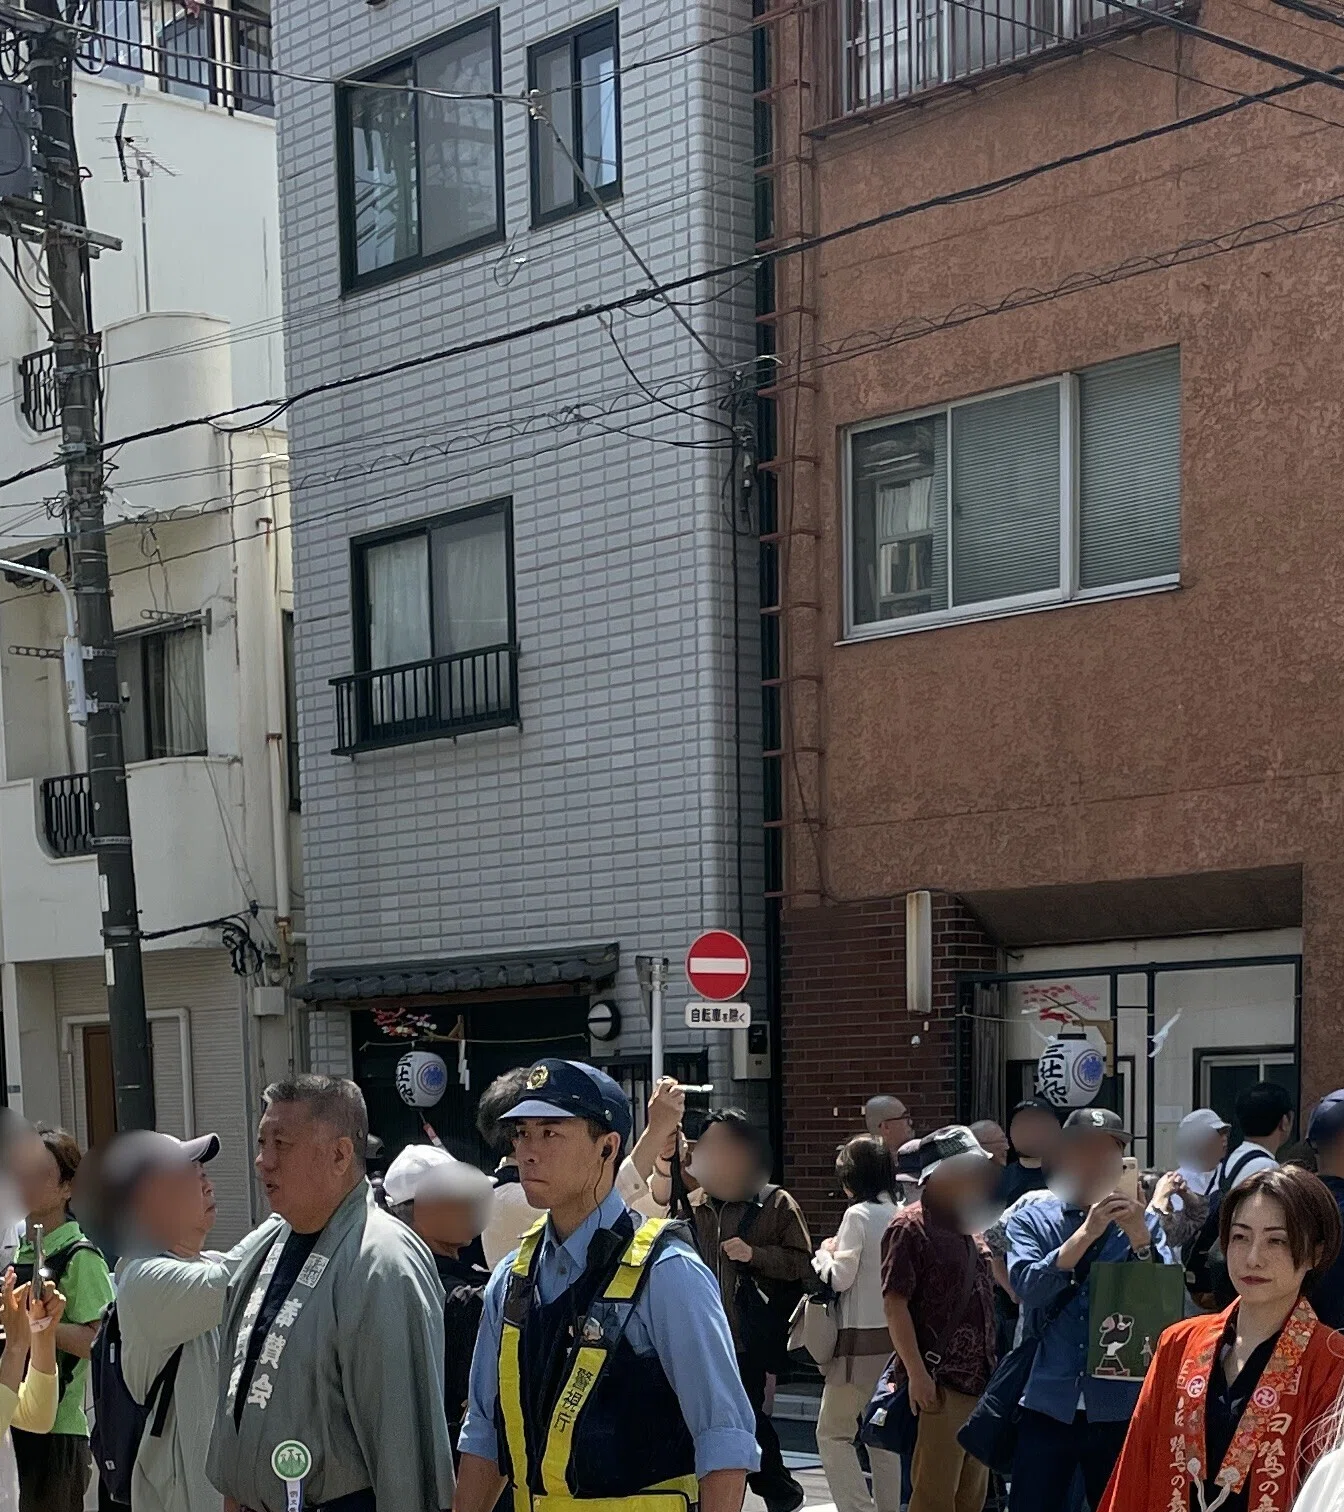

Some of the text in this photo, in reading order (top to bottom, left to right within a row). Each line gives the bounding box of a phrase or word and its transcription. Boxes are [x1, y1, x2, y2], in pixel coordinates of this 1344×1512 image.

[690, 1007, 746, 1023] 自転車を除く
[1091, 1110, 1105, 1127] S
[554, 1367, 594, 1433] 警視庁
